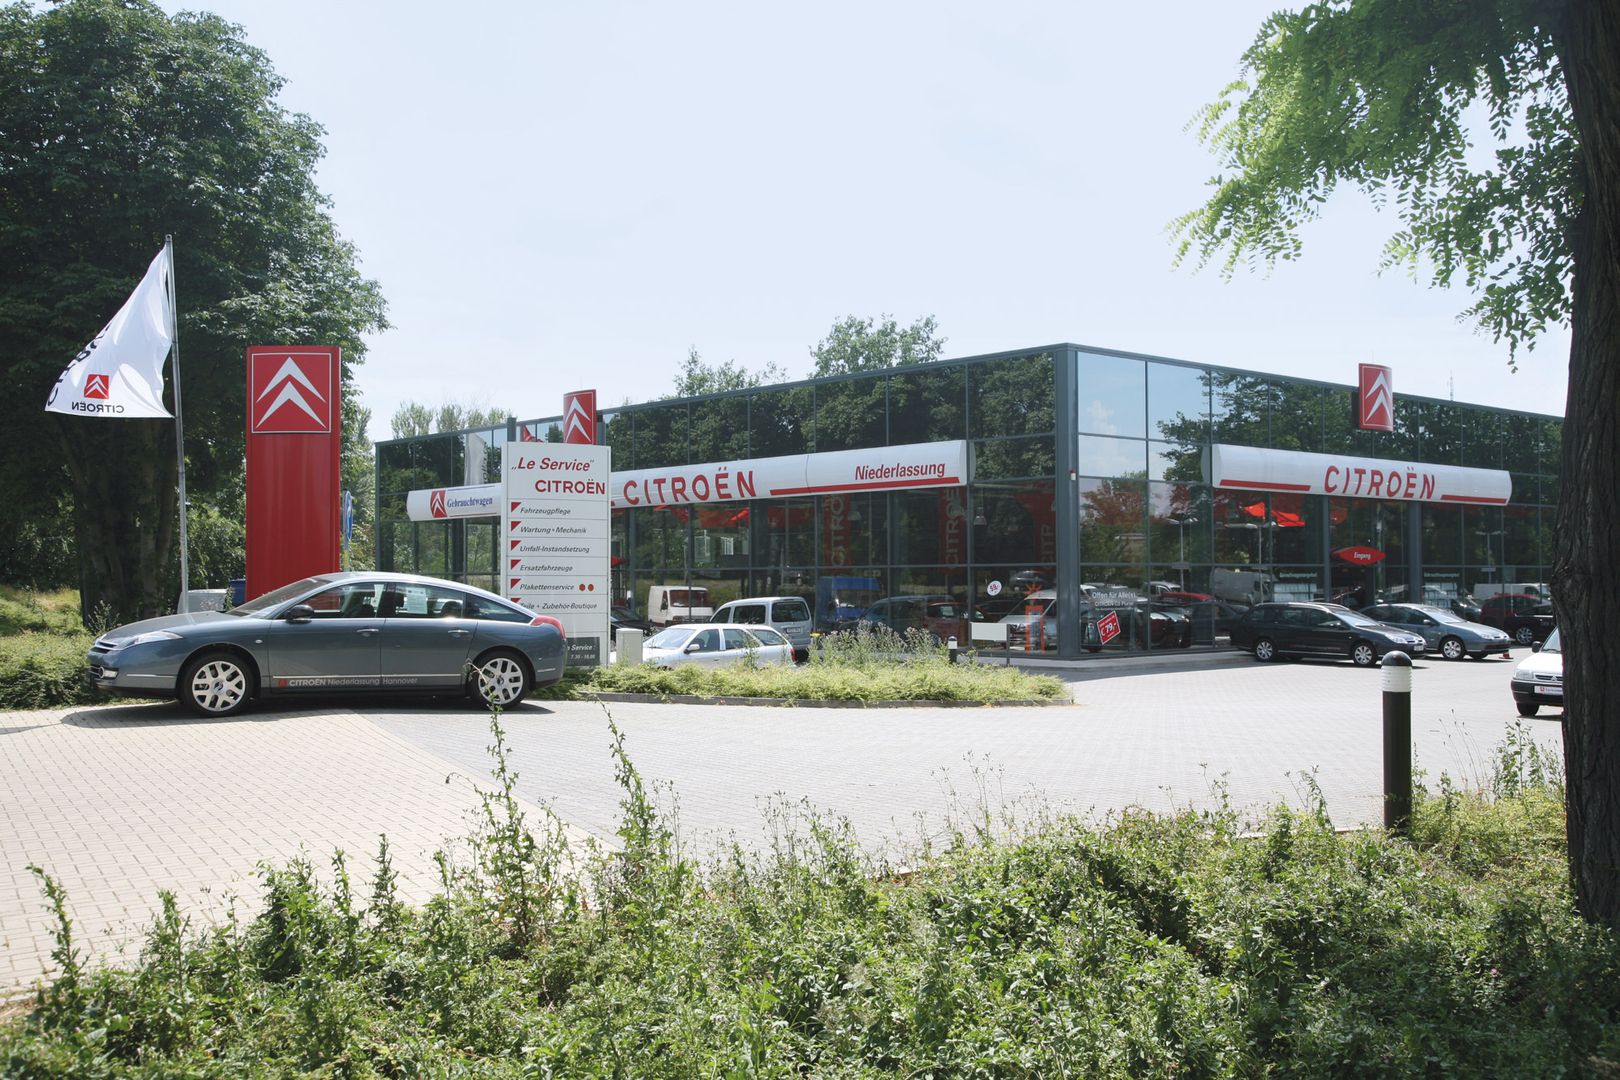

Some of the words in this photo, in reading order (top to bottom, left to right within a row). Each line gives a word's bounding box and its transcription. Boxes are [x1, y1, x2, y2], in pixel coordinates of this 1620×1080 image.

[855, 463, 946, 480] Niederlassung
[535, 478, 605, 494] CITROËN
[623, 466, 757, 505] CITROËN
[1325, 465, 1435, 499] CITROËN
[447, 497, 493, 508] Gebrauchtwagen
[520, 507, 571, 515] Fahrzeugpflege
[520, 526, 551, 534] Wartung
[555, 526, 587, 534] Mechanik
[520, 564, 573, 572] Ersatzfahrzeuge
[327, 678, 380, 686] Niederlassung
[382, 677, 418, 685] Hannover
